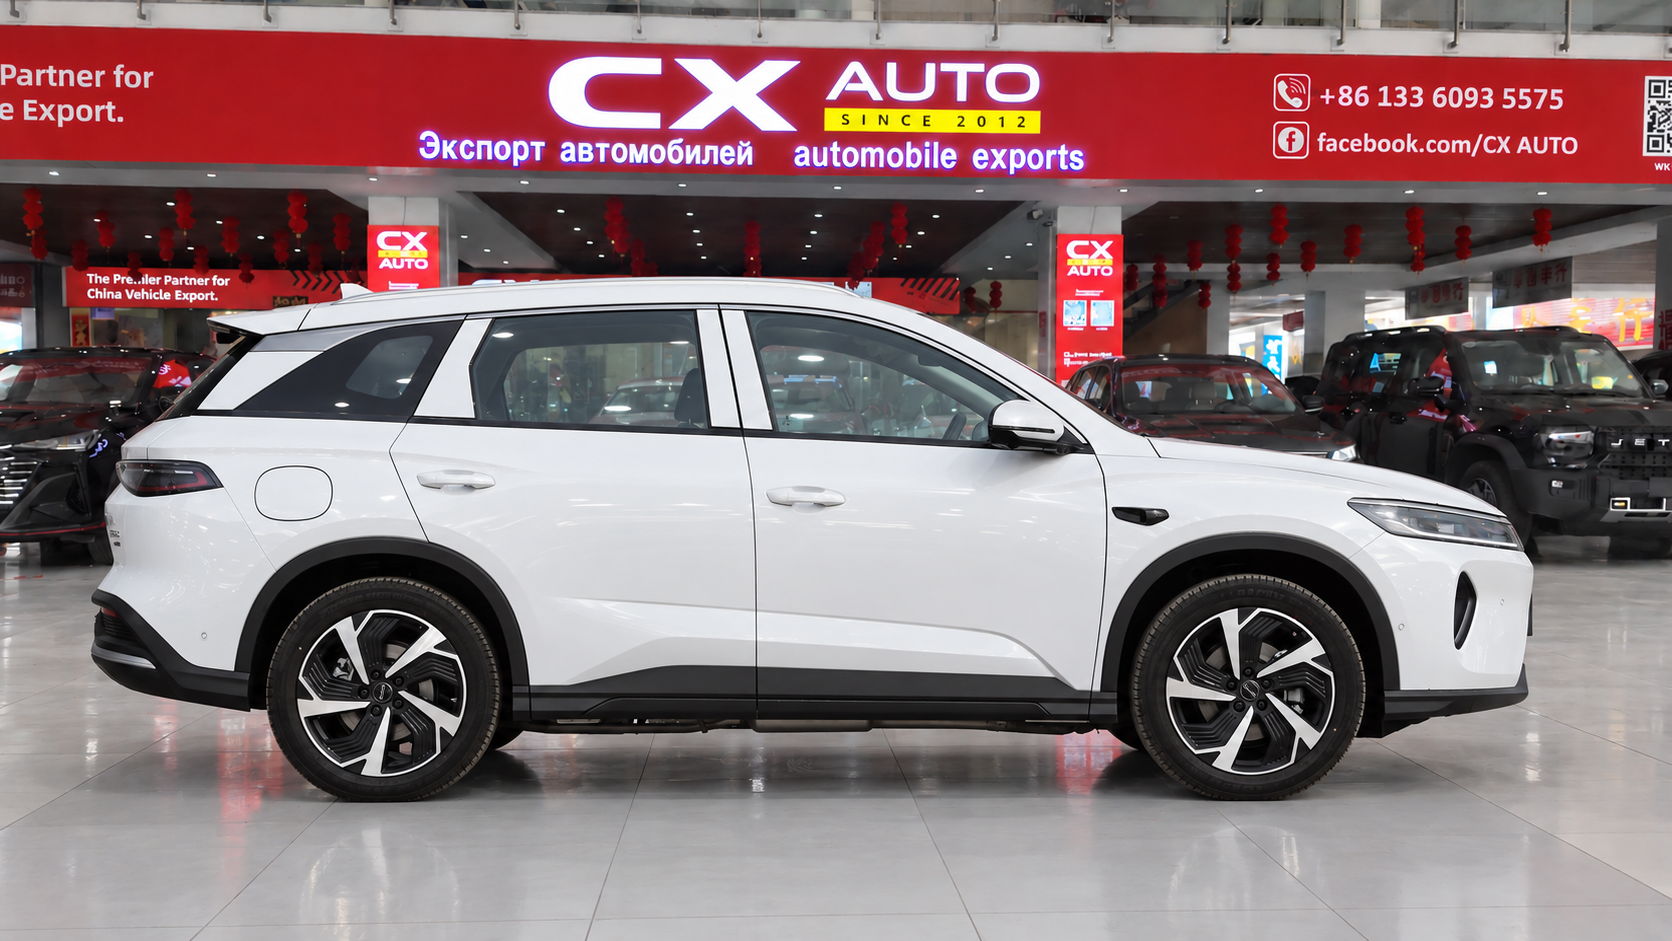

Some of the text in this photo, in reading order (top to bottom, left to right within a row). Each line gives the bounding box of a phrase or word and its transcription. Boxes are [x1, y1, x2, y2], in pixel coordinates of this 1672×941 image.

[0, 63, 154, 89] Partner for
[548, 56, 1040, 132] CX AUTO
[1319, 85, 1564, 110] +86 133 6093 5575
[23, 99, 124, 128] Export.
[841, 113, 1026, 128] SINCE 2012
[418, 130, 754, 167] Экспорт автомобилей
[1316, 132, 1579, 158] facebook.com/CX AUTO
[793, 140, 1085, 174] automobile exports
[376, 230, 428, 251] CX
[1066, 240, 1113, 259] CX
[378, 257, 429, 270] AUTO
[1066, 265, 1113, 277] AUTO
[86, 273, 110, 285] The
[164, 275, 210, 287] Partner
[211, 274, 231, 287] for
[86, 287, 219, 304] China Vehicle Export.
